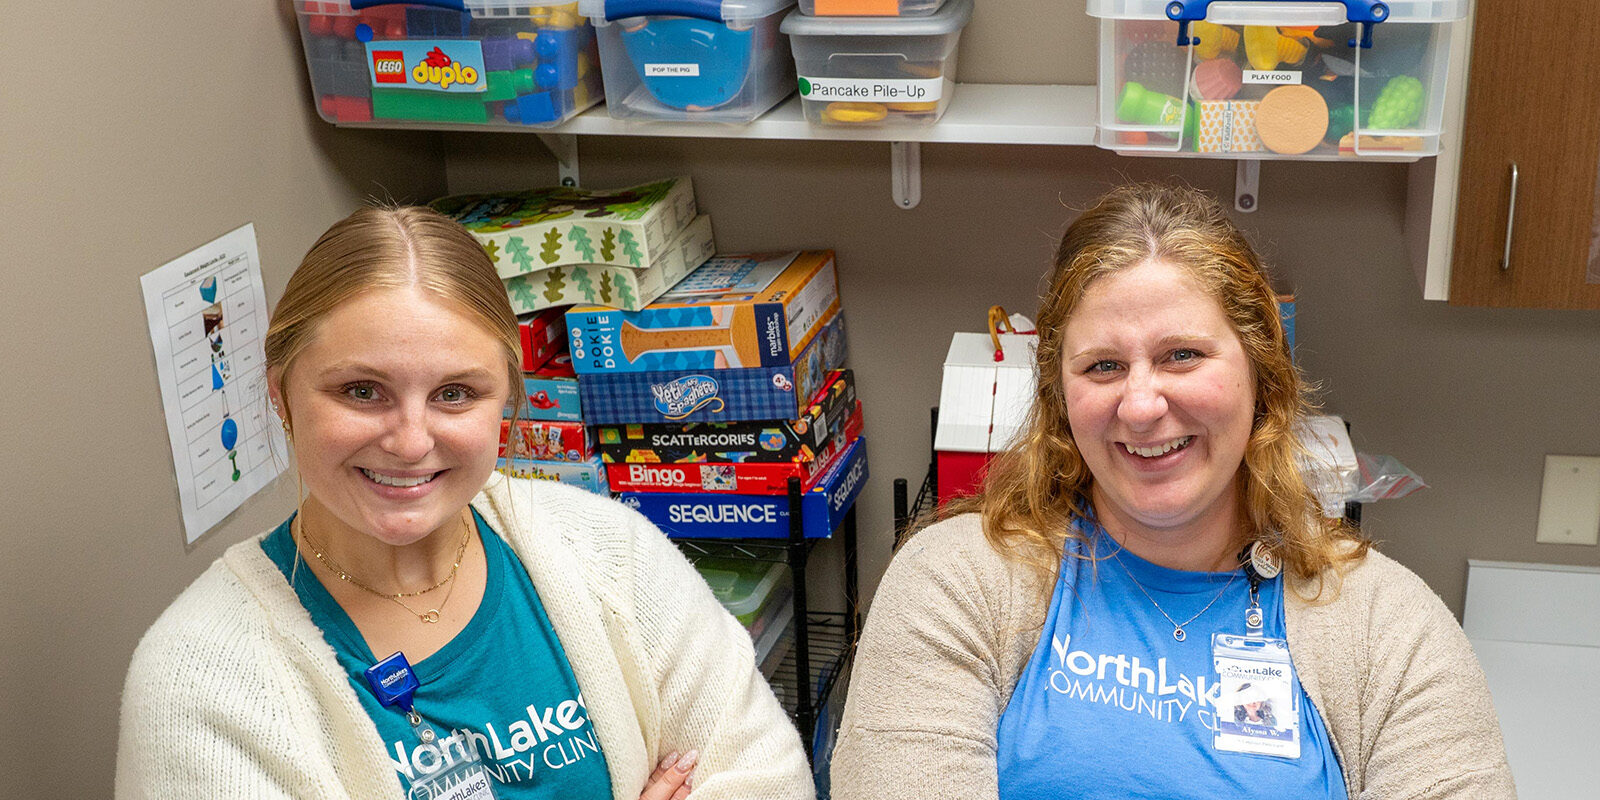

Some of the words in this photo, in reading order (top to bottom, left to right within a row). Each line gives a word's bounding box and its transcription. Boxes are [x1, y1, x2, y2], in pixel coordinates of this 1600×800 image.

[377, 60, 402, 73] LEGO
[412, 61, 478, 89] duplo
[812, 83, 869, 97] Pancake
[873, 84, 926, 99] Pile-Up
[766, 320, 779, 357] marbles
[652, 382, 682, 403] Yeti
[668, 382, 716, 415] Spaghetti
[652, 433, 756, 446] SCATTERGORIES
[629, 464, 686, 487] Bingo
[668, 504, 777, 524] SEQUENCE
[1052, 633, 1221, 708] NorthLak
[1045, 667, 1193, 723] OMMUNITY
[543, 730, 599, 769] CLIN
